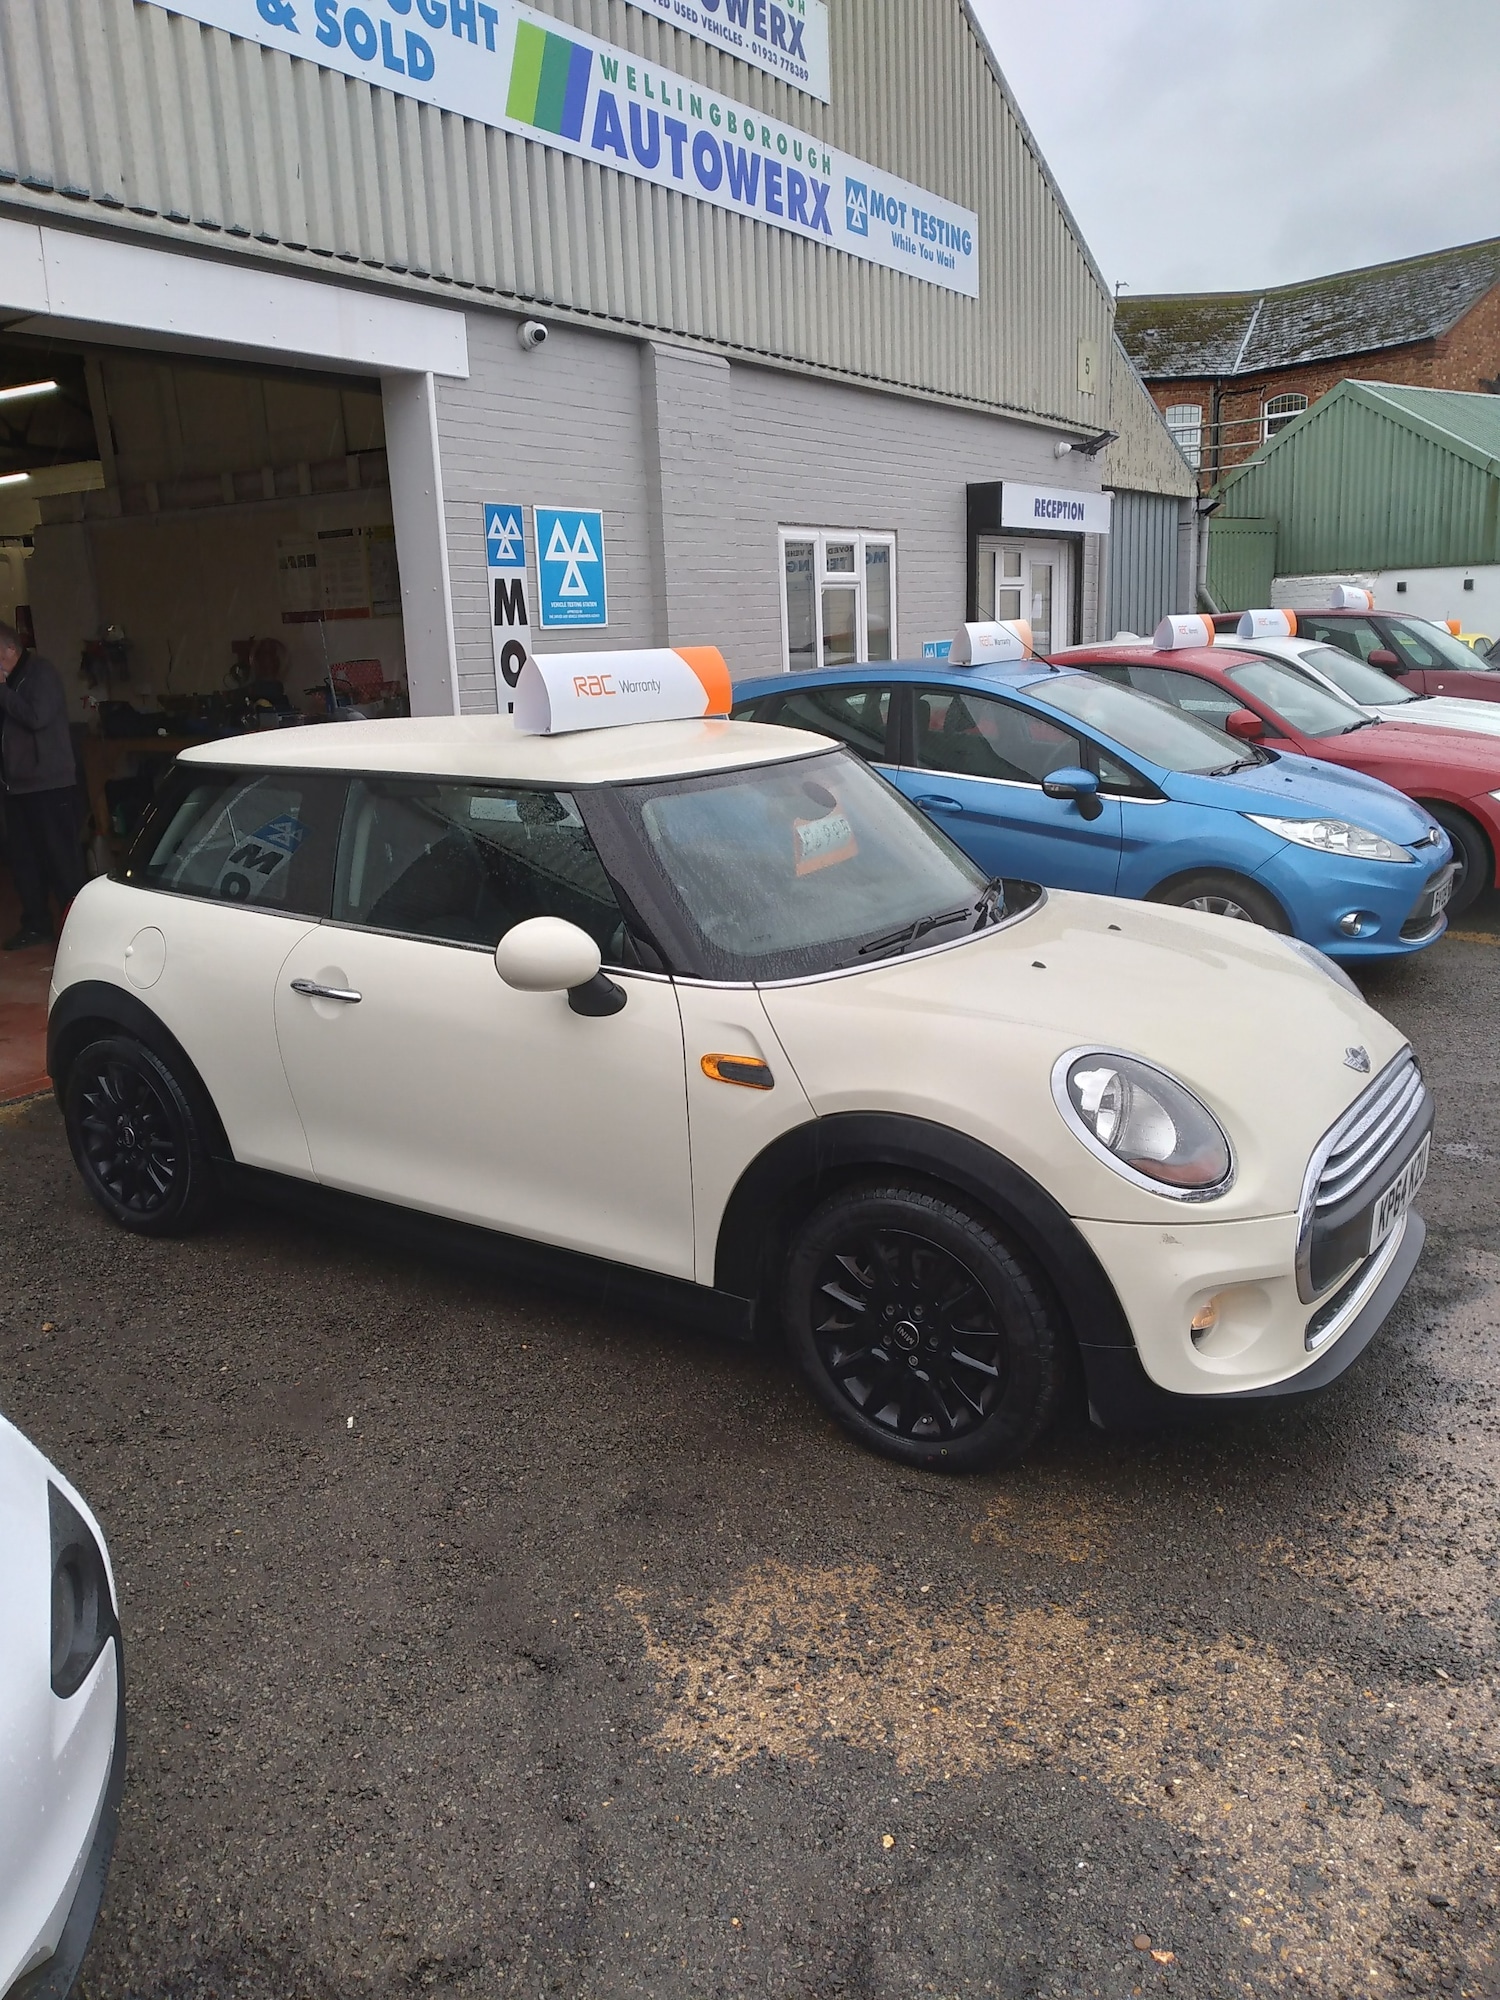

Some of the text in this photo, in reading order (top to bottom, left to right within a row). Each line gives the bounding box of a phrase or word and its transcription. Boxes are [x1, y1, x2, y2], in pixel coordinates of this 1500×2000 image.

[315, 0, 436, 82] SOLD
[674, 2, 698, 24] USED
[701, 14, 743, 47] VEHICLES
[752, 41, 778, 66] 01933
[780, 56, 809, 82] 778389
[701, 0, 807, 63] WERX
[600, 53, 832, 176] WELLINGBOROUGH
[591, 89, 833, 236] AUTOWERX
[870, 190, 972, 256] MOT TESTING
[891, 231, 955, 270] While You Wait
[1085, 357, 1090, 375] 5
[1034, 497, 1085, 521] RECEPTION
[494, 578, 529, 714] MO
[619, 679, 661, 694] Warranty
[897, 1325, 915, 1345] MINI
